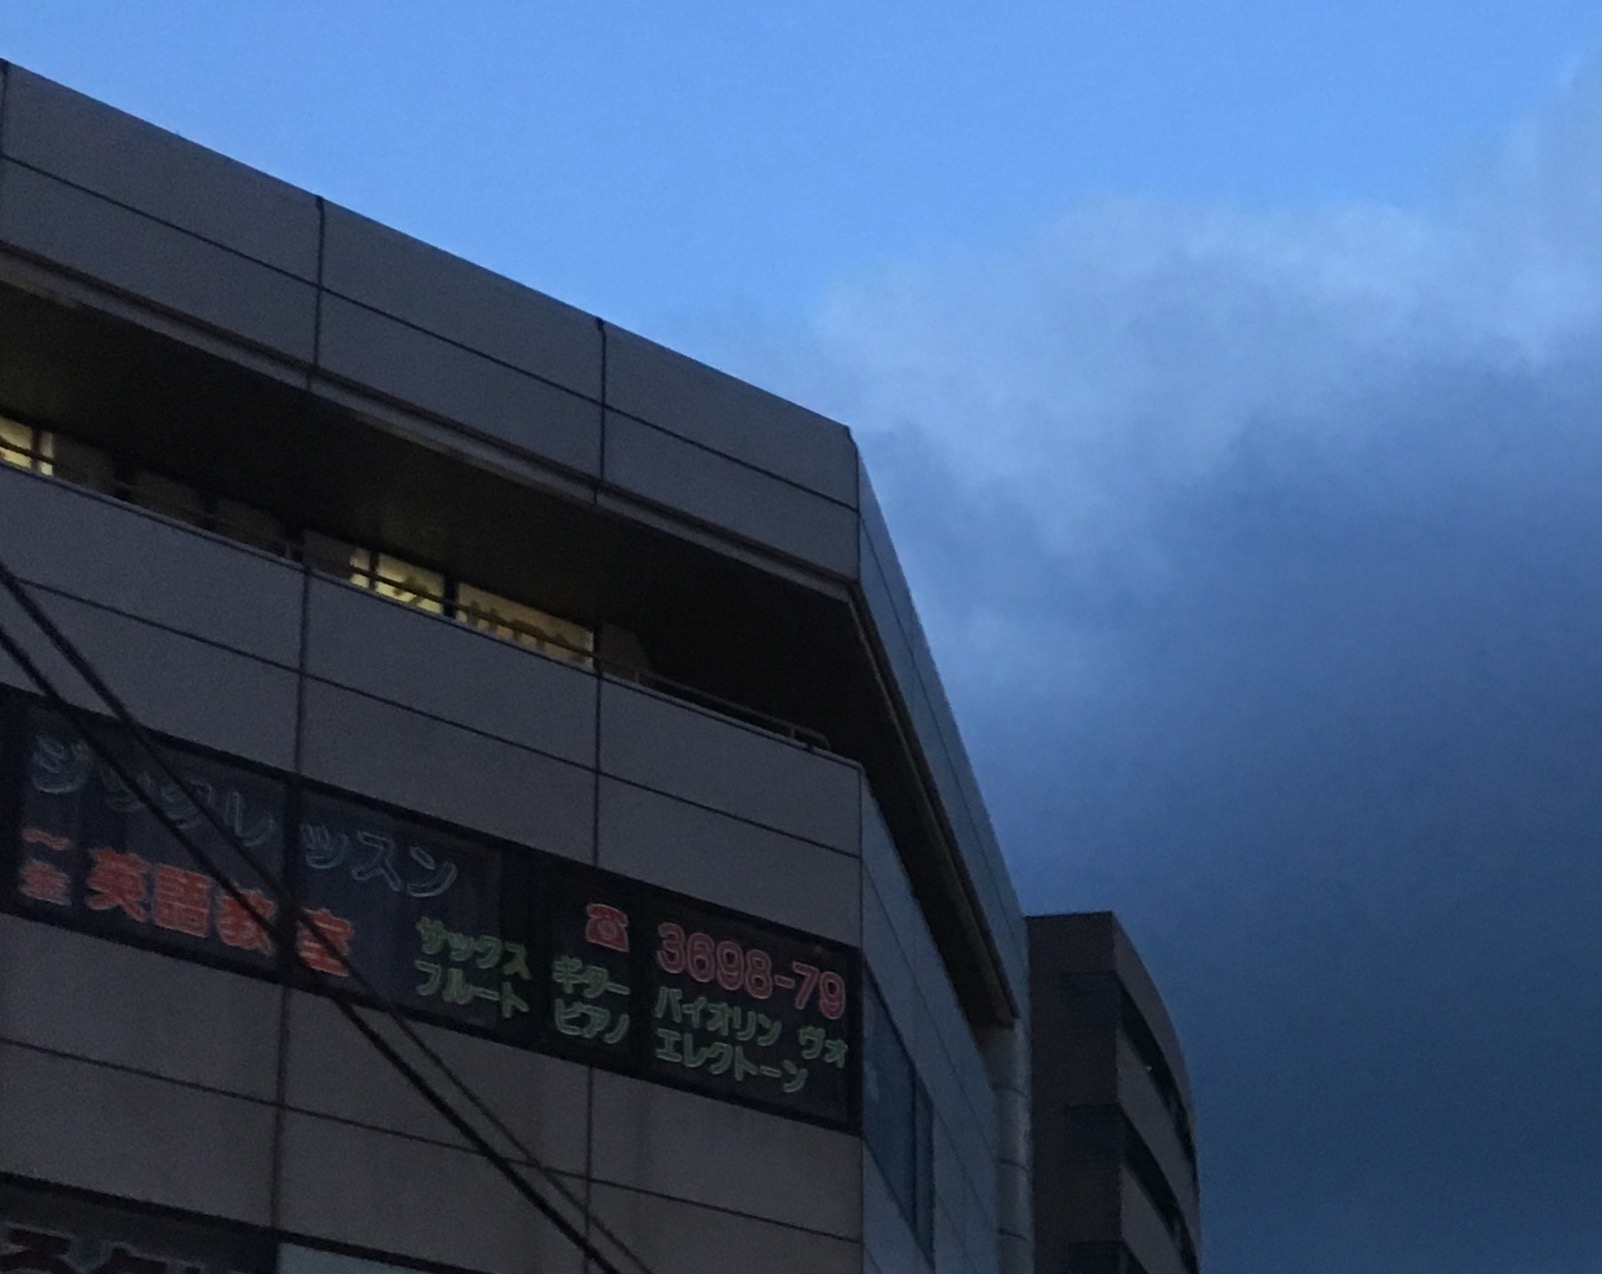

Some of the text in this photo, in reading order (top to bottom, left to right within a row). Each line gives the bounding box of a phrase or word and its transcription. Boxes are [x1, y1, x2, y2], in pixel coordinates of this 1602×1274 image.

[656, 985, 783, 1048] バイオリン
[656, 1027, 808, 1094] エレクトーン
